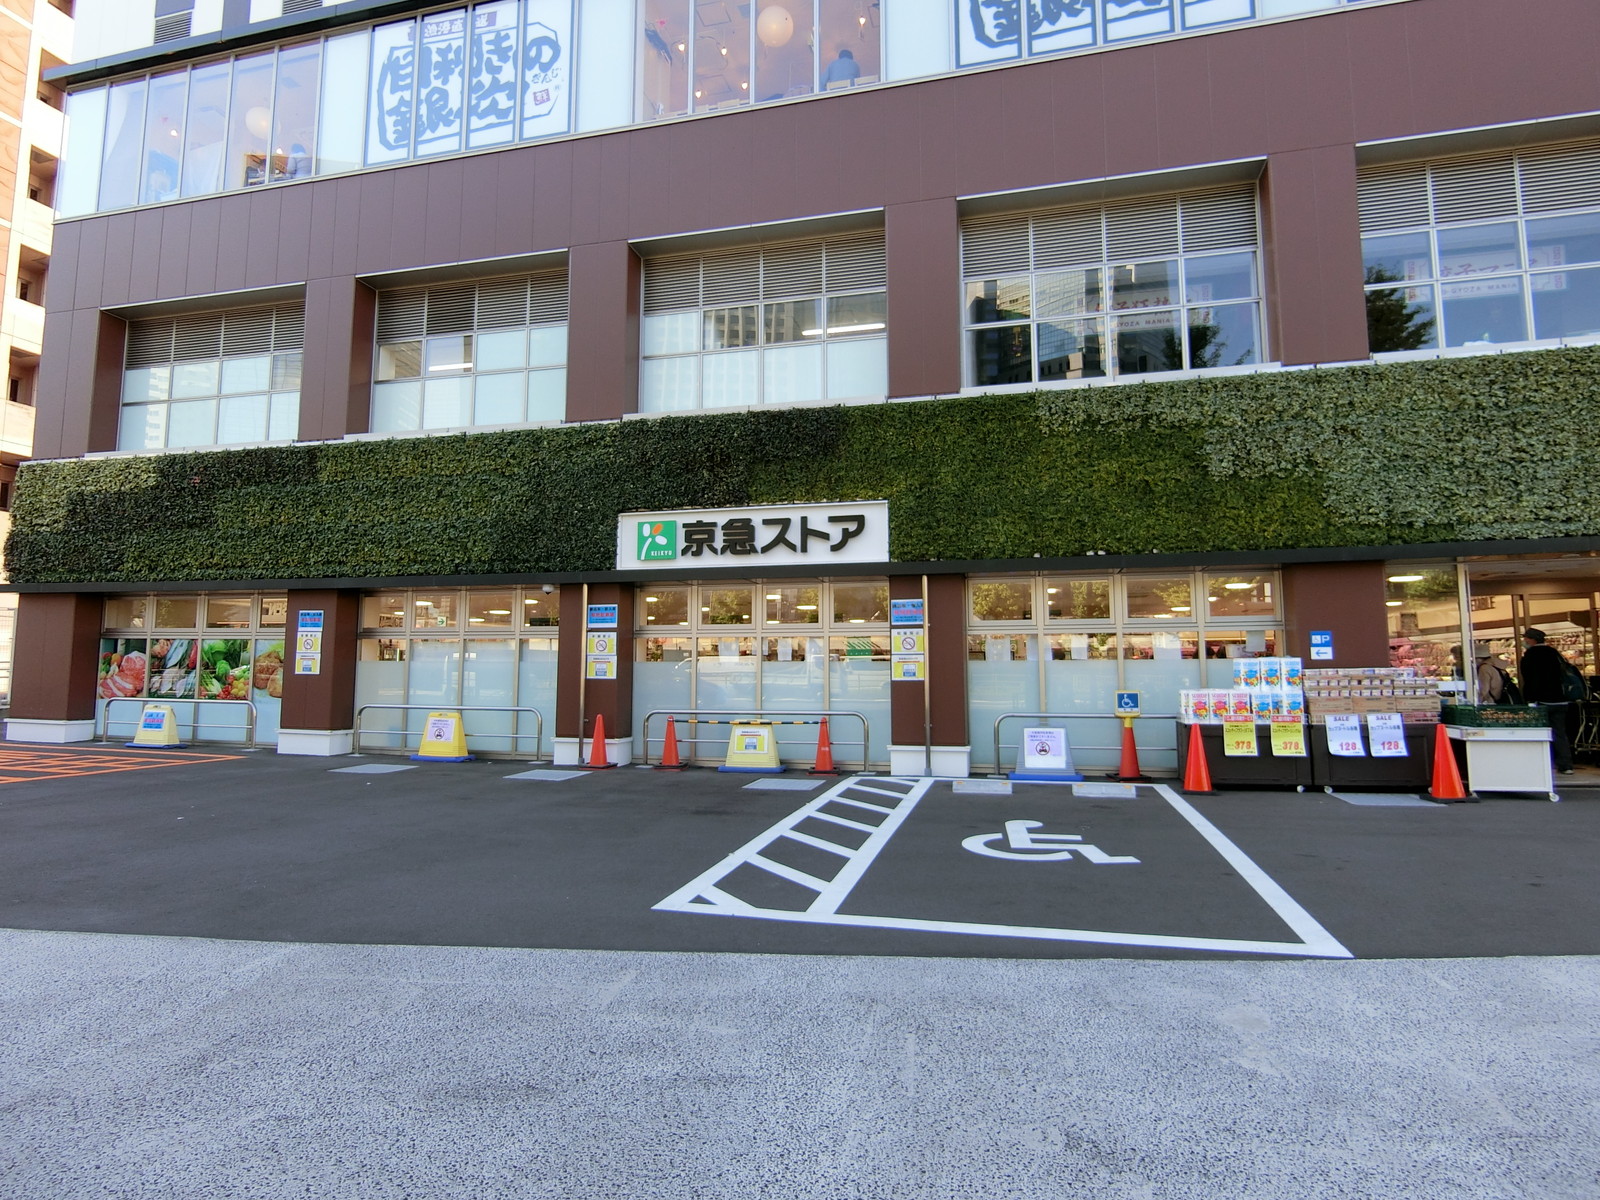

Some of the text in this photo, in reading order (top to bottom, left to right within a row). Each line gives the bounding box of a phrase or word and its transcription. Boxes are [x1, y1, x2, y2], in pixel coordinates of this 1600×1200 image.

[388, 31, 561, 94] 目利きの
[386, 75, 531, 144] 銀次
[1487, 282, 1517, 290] MANIA
[681, 514, 866, 557] 京急ストア
[1321, 635, 1330, 644] P
[1235, 740, 1252, 750] 378
[1282, 741, 1300, 751] 378
[1339, 742, 1357, 751] 128
[1381, 741, 1399, 751] 128
